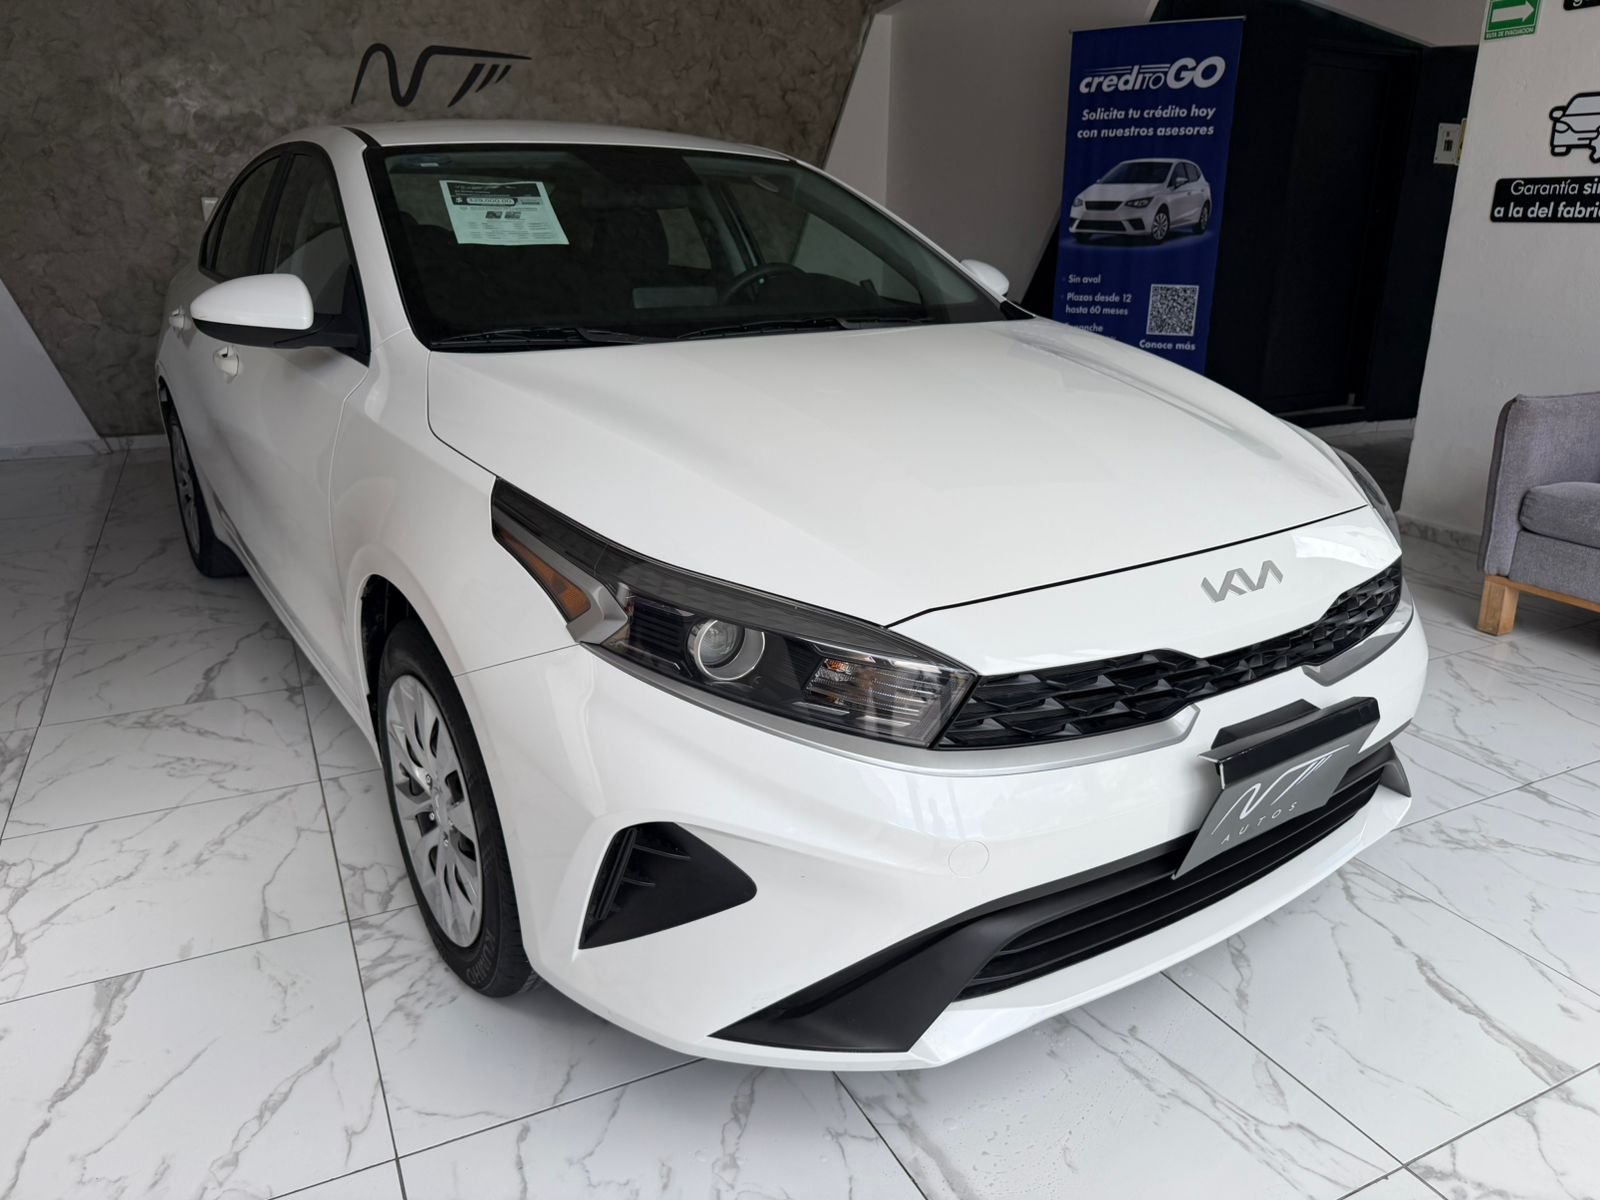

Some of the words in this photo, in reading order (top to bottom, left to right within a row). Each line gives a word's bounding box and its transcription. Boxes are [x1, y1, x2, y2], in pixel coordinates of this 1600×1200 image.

[1081, 107, 1126, 121] Solicita
[1128, 108, 1141, 119] tu
[1143, 105, 1188, 119] crédito
[1190, 104, 1217, 120] hoy
[1077, 129, 1098, 139] con
[1100, 126, 1154, 137] nuestros
[1156, 126, 1215, 136] asesores
[1510, 179, 1579, 196] Garantía
[1582, 177, 1600, 196] si
[1493, 205, 1505, 218] a
[1508, 201, 1523, 218] la
[1526, 201, 1554, 218] del
[1557, 201, 1600, 218] fabri
[1067, 274, 1081, 285] Sin
[1082, 274, 1102, 284] aval
[1066, 292, 1093, 303] Plazas
[1094, 292, 1120, 302] desde
[1122, 293, 1133, 303] 12
[1065, 304, 1089, 315] hasta
[1089, 304, 1102, 316] 60
[1102, 307, 1129, 316] meses
[1138, 339, 1173, 350] Conoce
[1175, 340, 1197, 351] más
[1220, 801, 1298, 845] AUTOS
